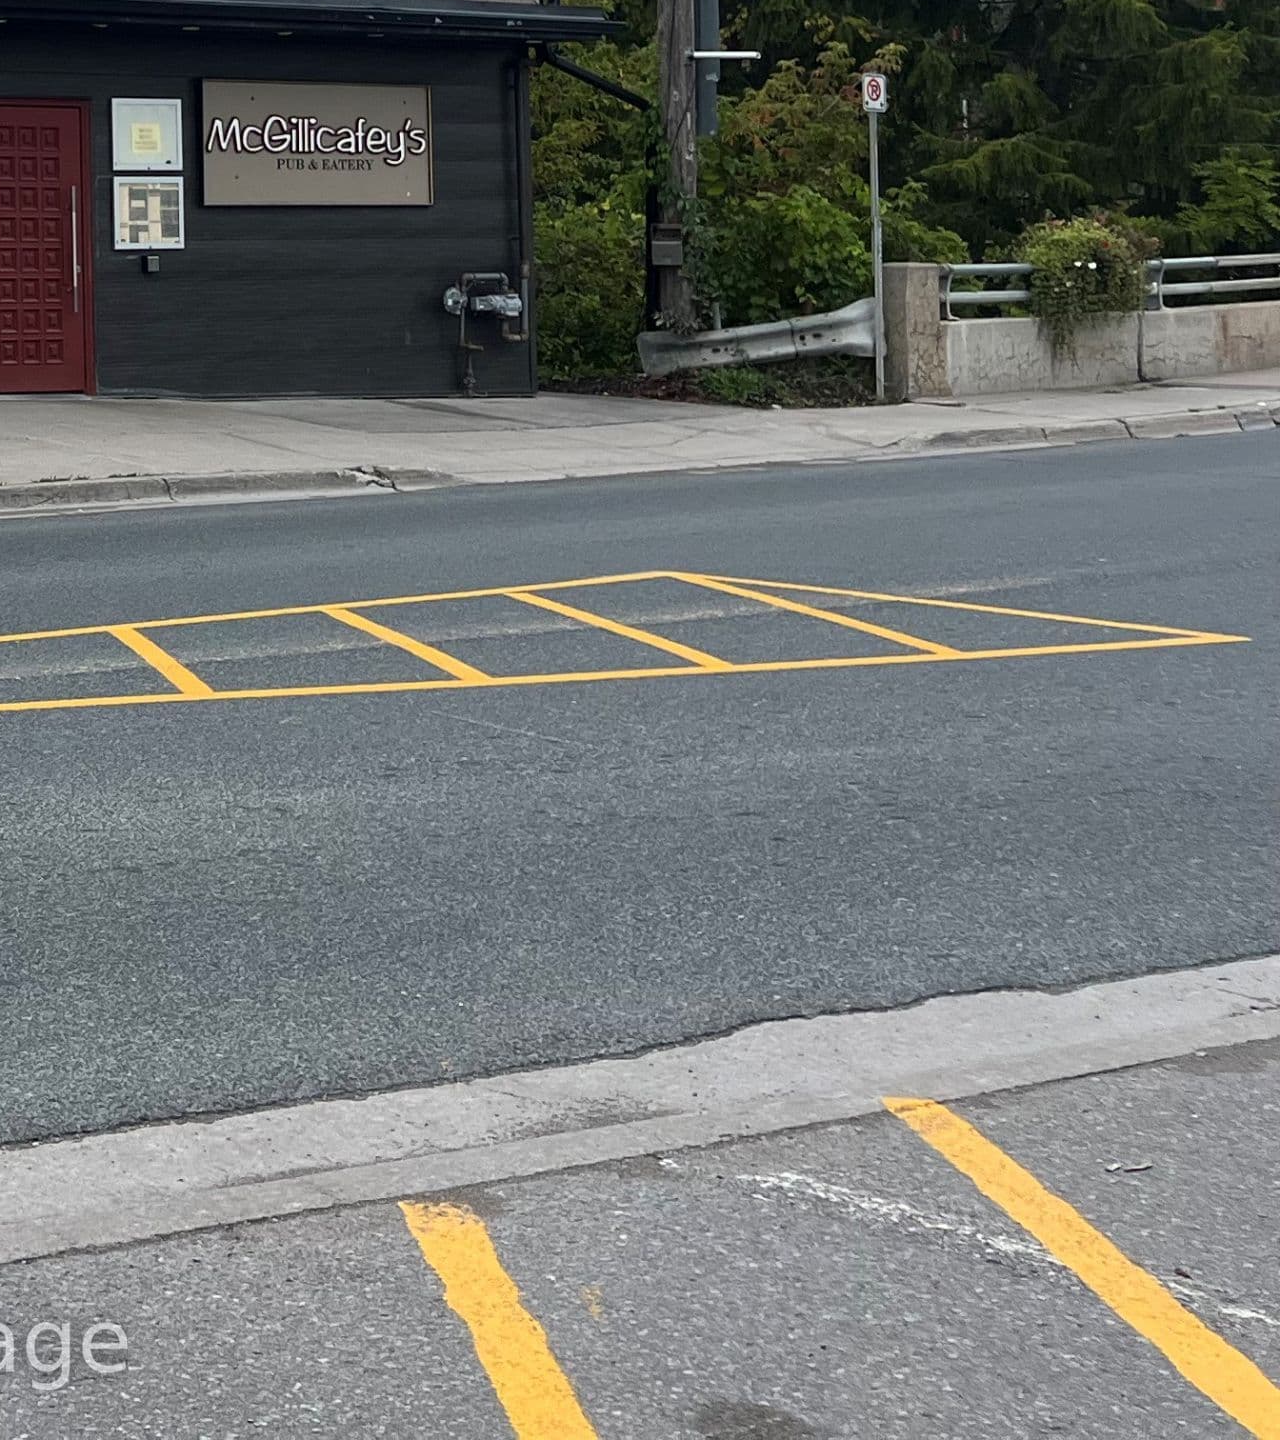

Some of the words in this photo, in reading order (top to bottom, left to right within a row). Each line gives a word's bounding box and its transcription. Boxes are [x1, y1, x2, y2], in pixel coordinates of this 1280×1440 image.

[206, 114, 427, 166] McGillicafey's
[276, 158, 305, 171] PUB
[308, 159, 320, 171] &
[322, 159, 375, 172] EATERY
